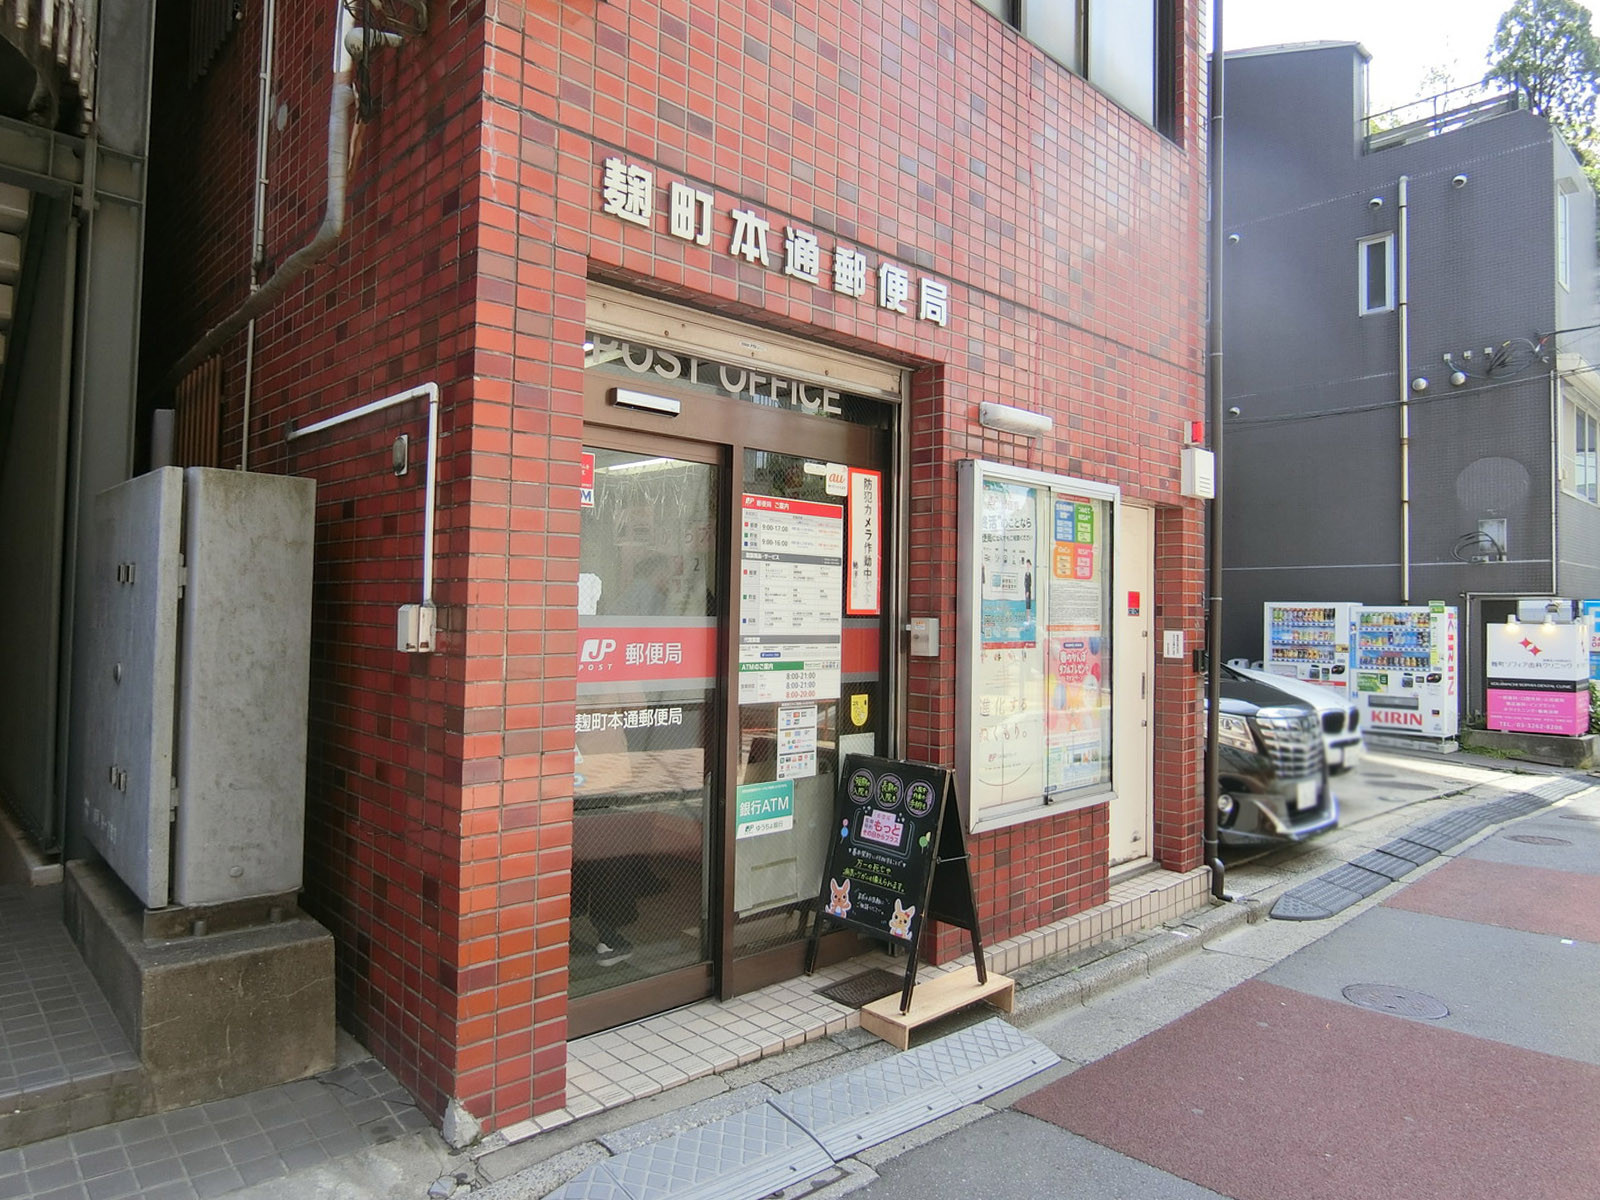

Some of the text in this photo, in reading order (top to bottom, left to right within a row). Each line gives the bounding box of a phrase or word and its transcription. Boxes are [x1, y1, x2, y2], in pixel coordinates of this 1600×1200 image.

[828, 472, 845, 483] au
[625, 642, 683, 665] 郵便局
[578, 663, 613, 672] POST
[1371, 710, 1423, 726] KIRIN
[739, 796, 790, 817] 銀行ATM
[873, 820, 901, 837] もっと
